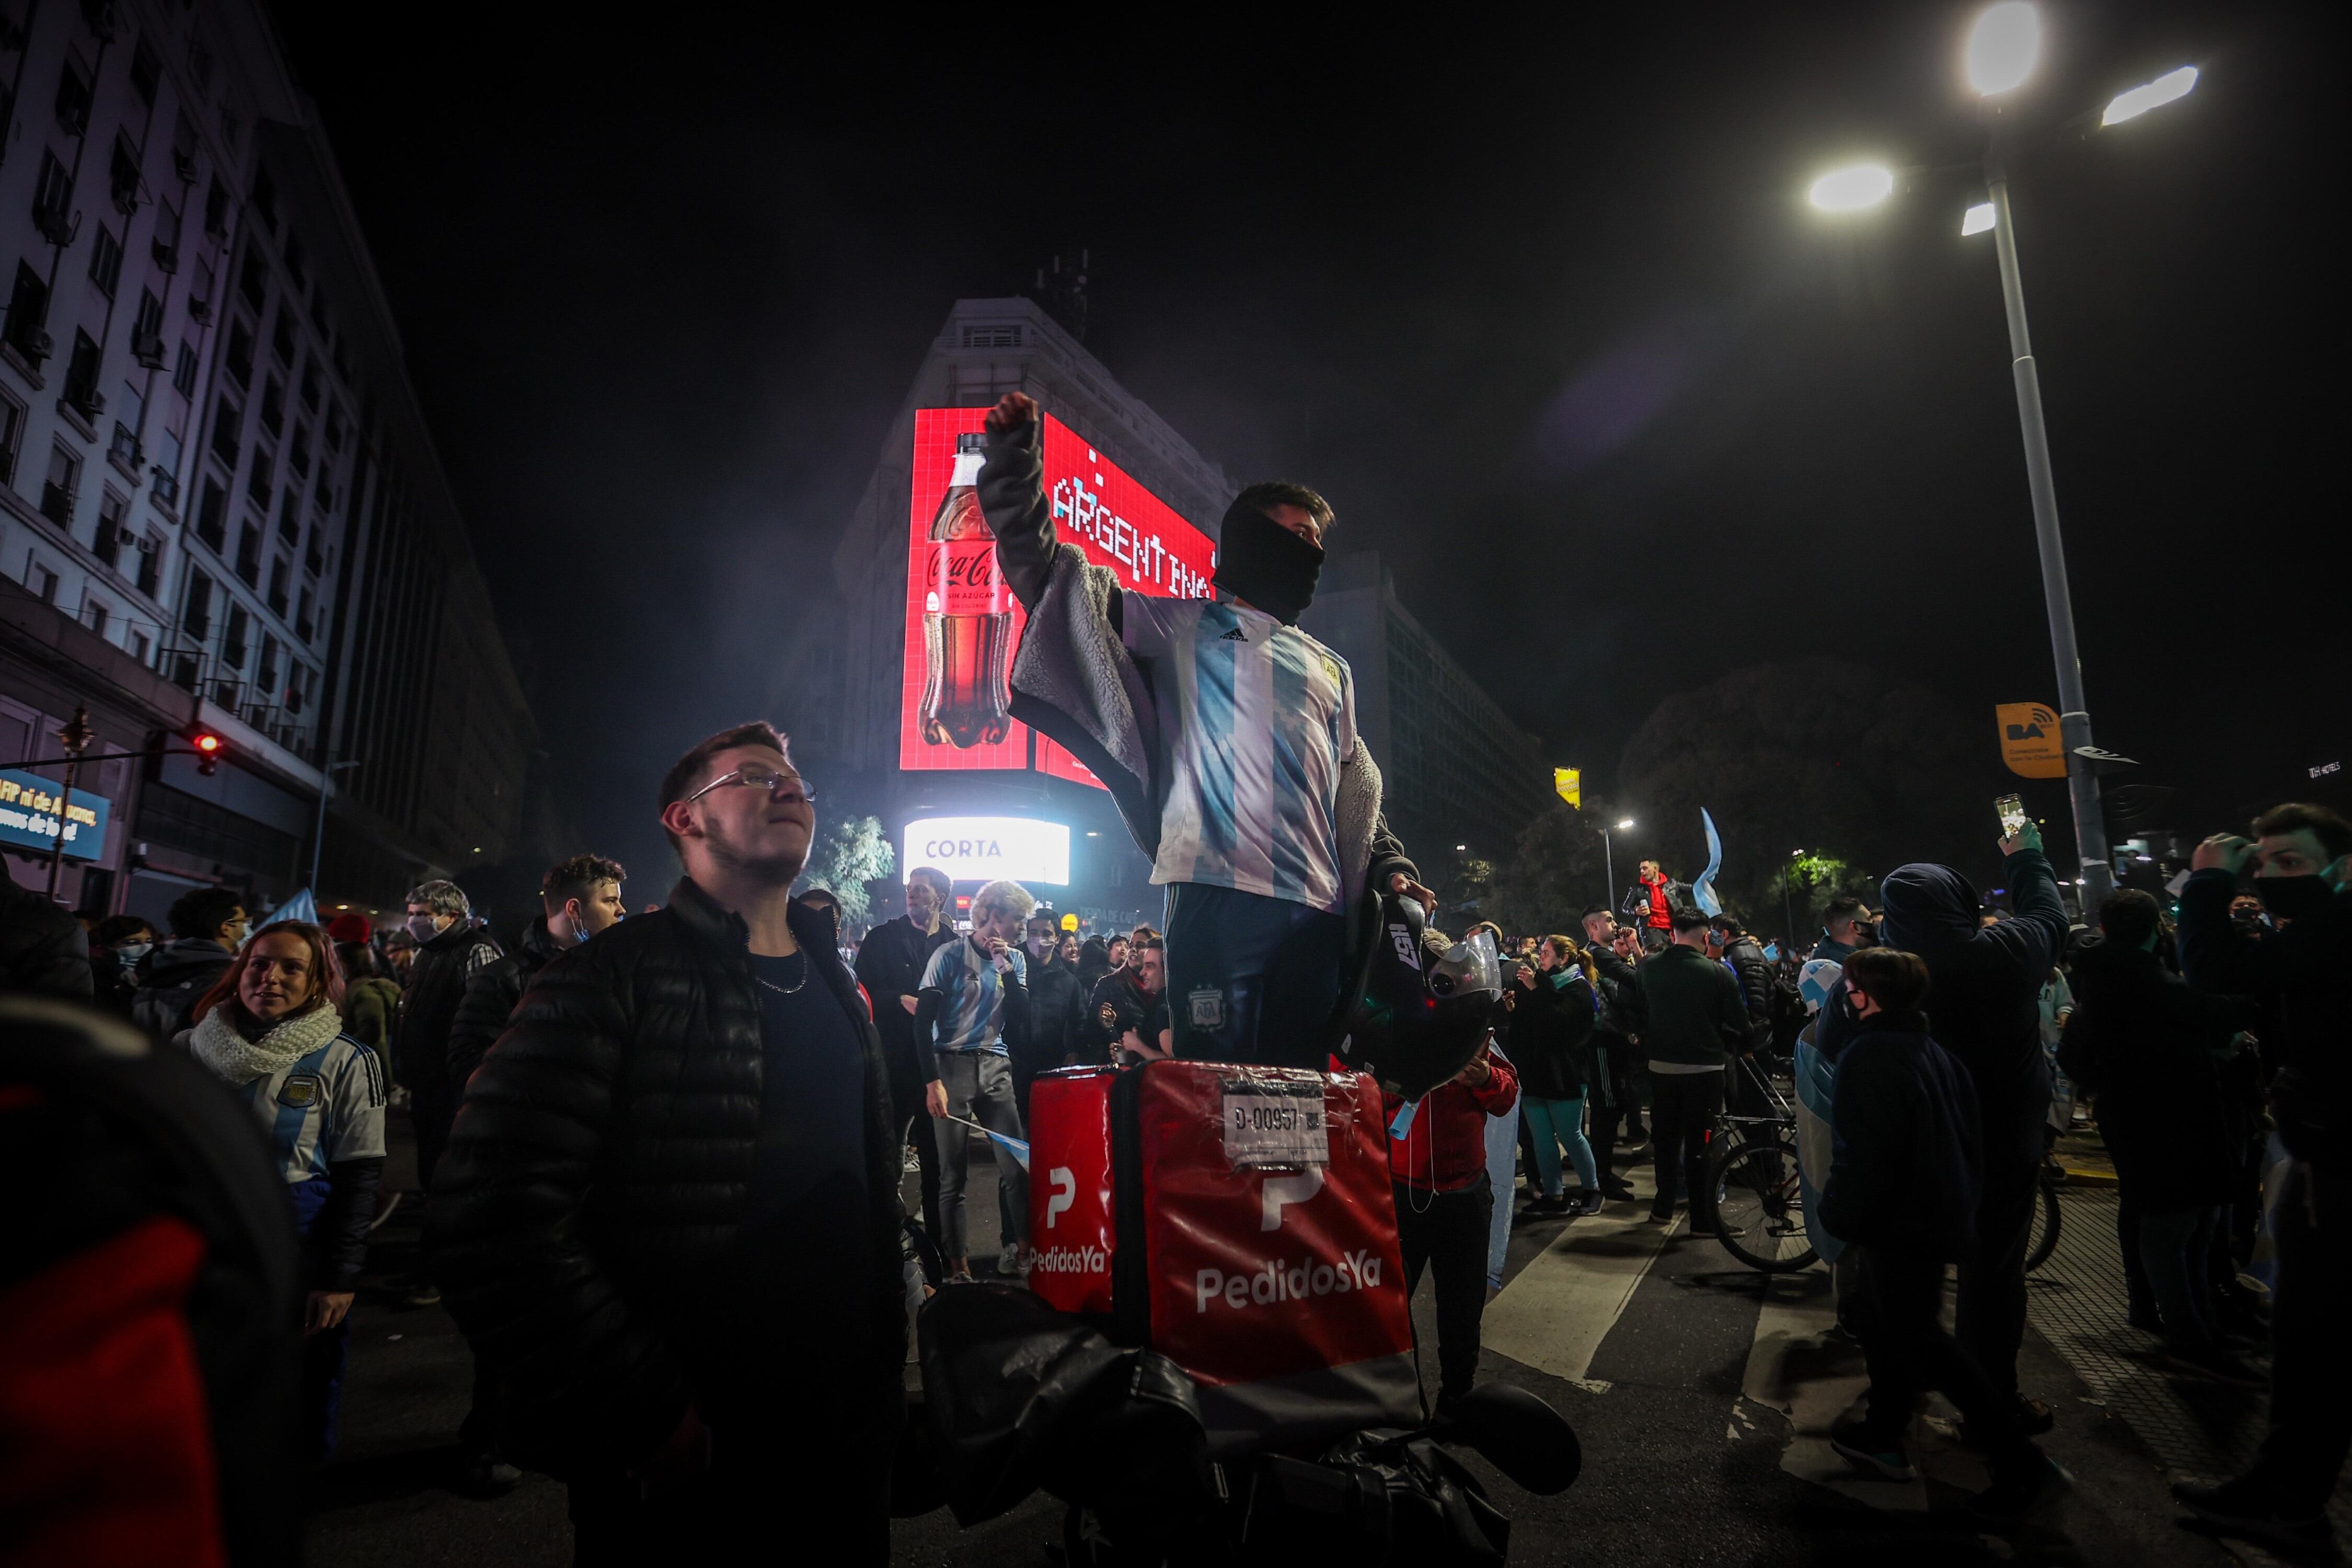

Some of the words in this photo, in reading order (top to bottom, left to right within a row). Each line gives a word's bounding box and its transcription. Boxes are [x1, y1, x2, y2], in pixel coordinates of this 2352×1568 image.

[1220, 634, 1249, 642] adidas
[926, 839, 1002, 858] CORTA
[1236, 1107, 1297, 1131] D-00957
[1029, 1246, 1104, 1273] PedidosYa
[1196, 1249, 1381, 1313] PedidosYa
